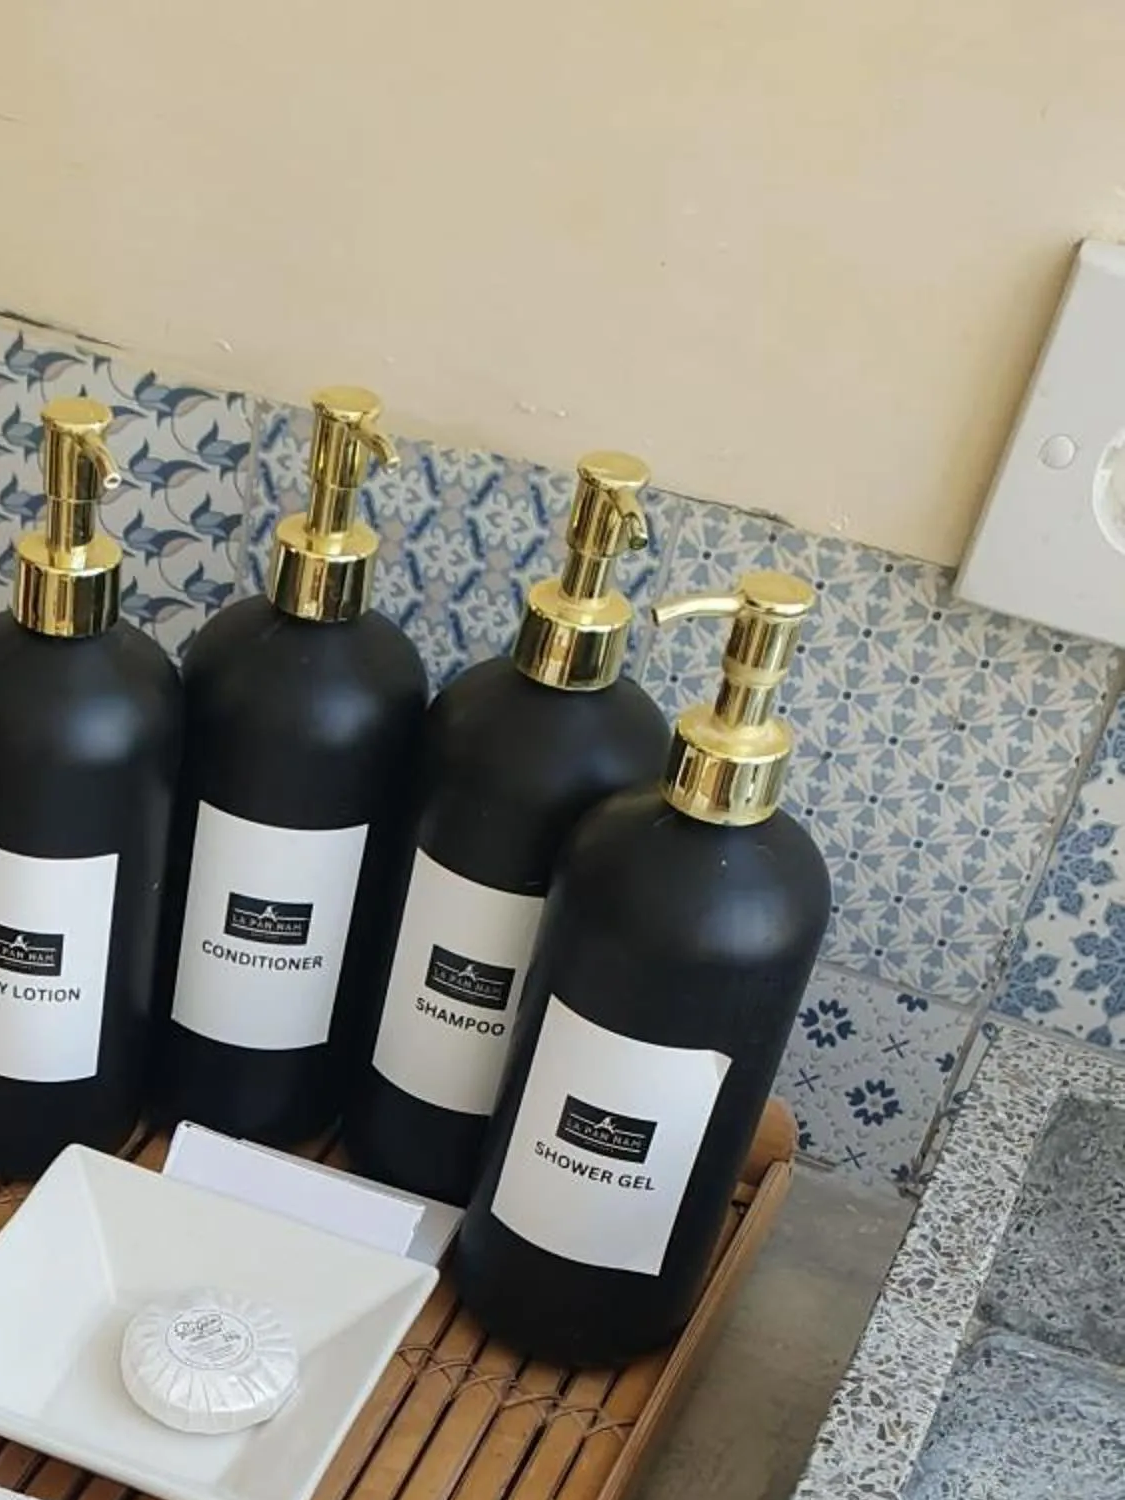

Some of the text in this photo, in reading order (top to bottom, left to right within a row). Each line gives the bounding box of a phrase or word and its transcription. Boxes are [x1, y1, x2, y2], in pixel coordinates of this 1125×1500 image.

[202, 939, 324, 971] CONDITIONER
[13, 985, 81, 1002] LOTION
[415, 997, 505, 1036] SHAMPOO
[535, 1141, 656, 1191] SHOWER GEL
